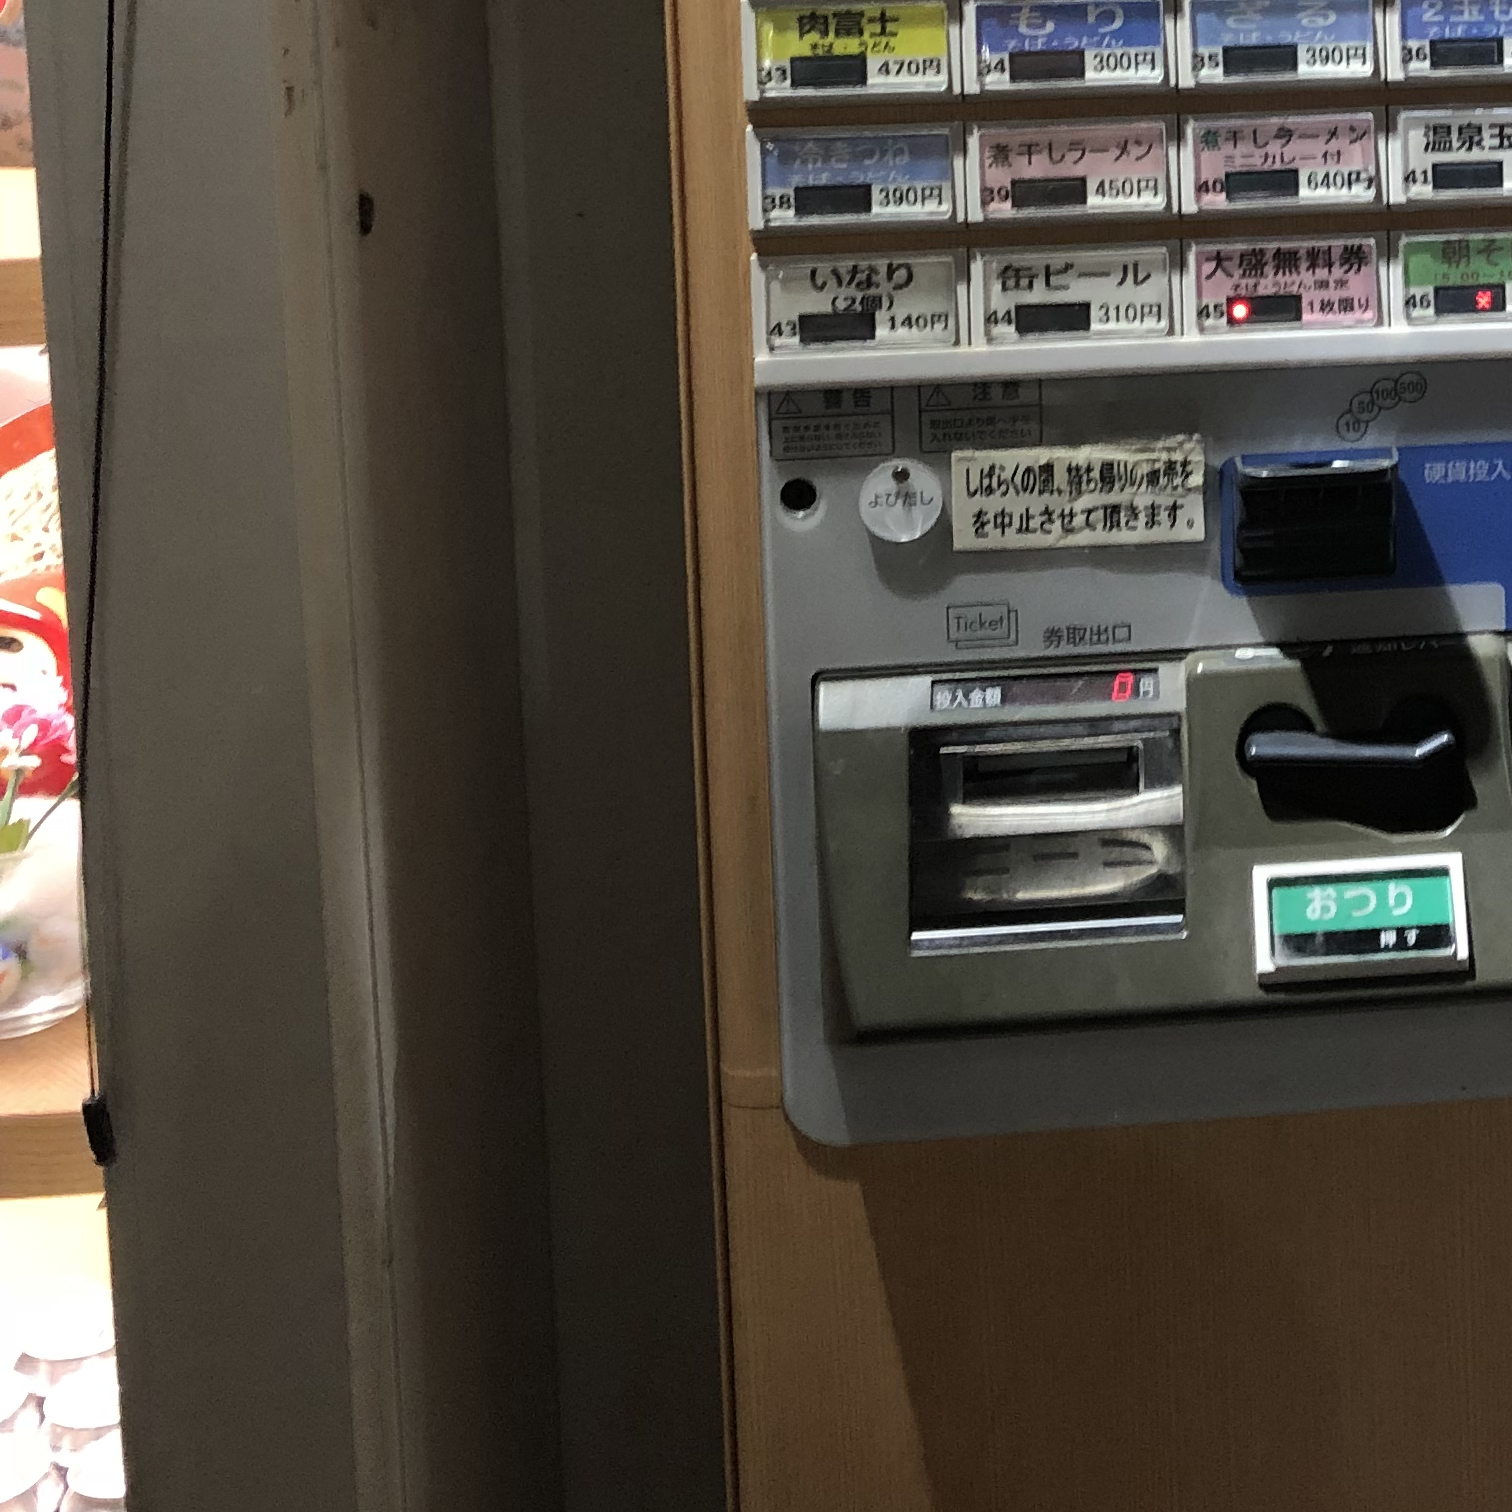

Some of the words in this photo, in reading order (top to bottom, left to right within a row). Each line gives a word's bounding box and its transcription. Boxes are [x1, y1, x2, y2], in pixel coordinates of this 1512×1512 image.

[797, 10, 900, 40] 肉富士
[1009, 6, 1124, 35] もり
[1093, 52, 1155, 73] 300円
[1306, 45, 1367, 66] 390円
[878, 58, 941, 76] 470円
[988, 140, 1153, 168] 煮干しラーメン
[1095, 177, 1158, 198] 450円
[1307, 171, 1373, 193] 640円
[879, 186, 942, 206] 390円
[1205, 246, 1370, 281] 大盛無料券
[810, 263, 913, 292] いなり
[1000, 261, 1151, 292] 缶ビール
[888, 313, 948, 331] 140円
[1098, 304, 1161, 324] 310円
[1401, 380, 1423, 394] 500
[868, 490, 934, 508] よびだし
[972, 500, 1194, 538] を中止させて頂きます。
[954, 612, 1004, 632] Ticket
[1042, 622, 1132, 649] 券取出口
[933, 687, 1001, 709] 投入金額
[1112, 672, 1135, 701] 0
[1139, 679, 1153, 698] 円
[1306, 882, 1413, 921] おつり
[1380, 929, 1420, 948] 押す
